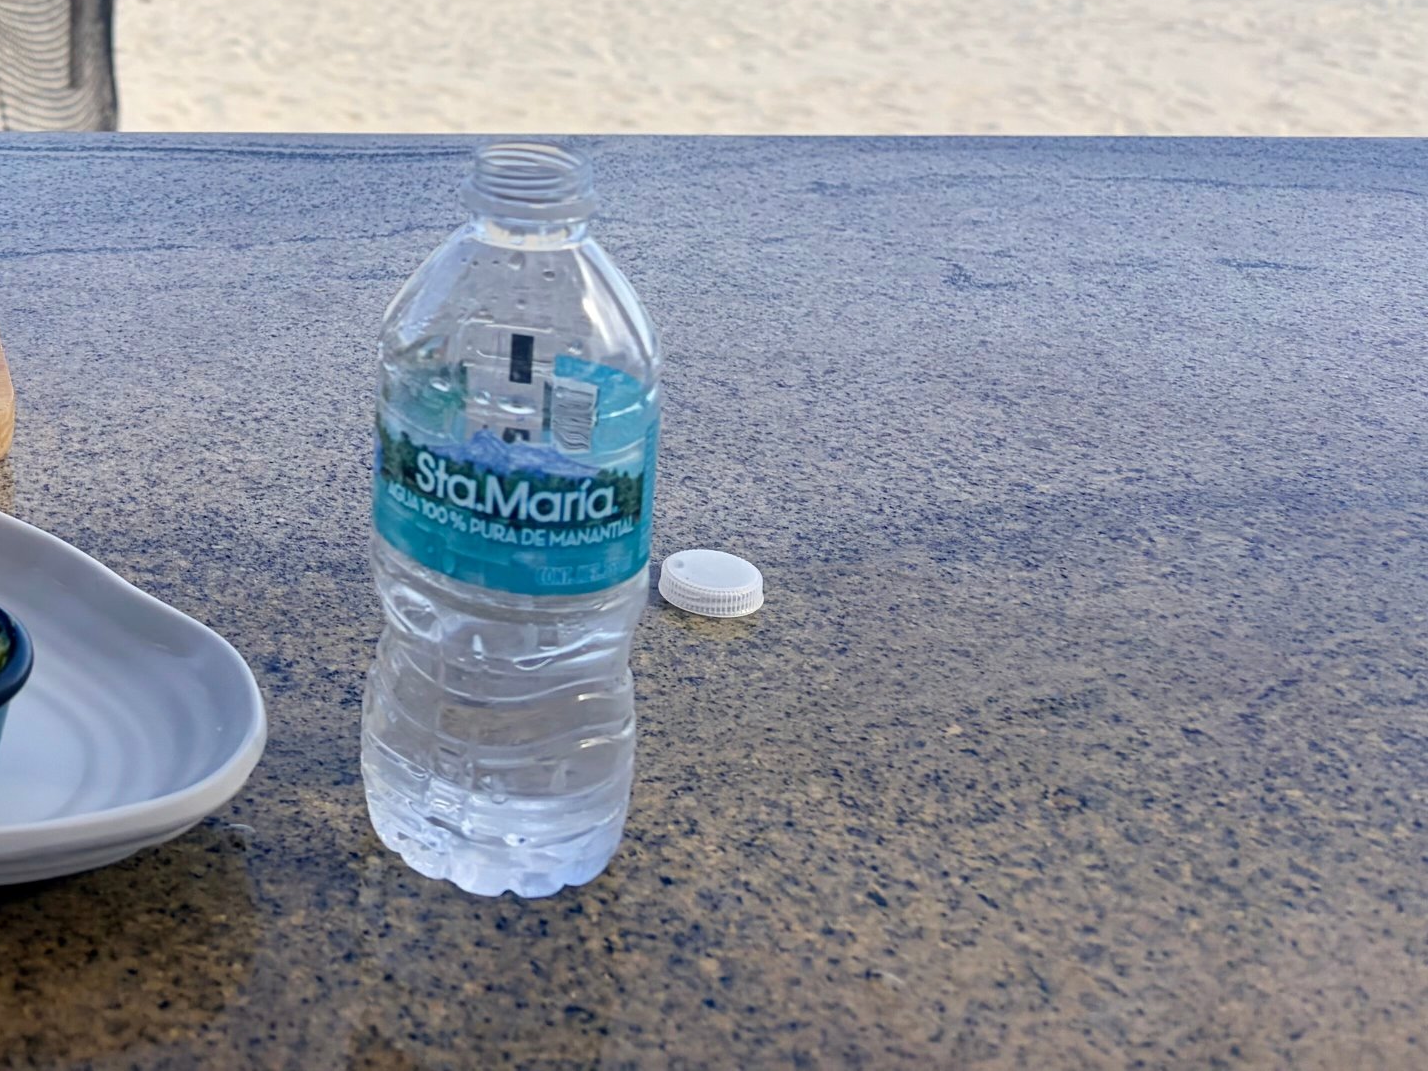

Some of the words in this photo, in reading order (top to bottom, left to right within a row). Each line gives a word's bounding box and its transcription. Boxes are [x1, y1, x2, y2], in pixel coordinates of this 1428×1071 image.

[388, 480, 420, 512] AGUA
[470, 517, 517, 545] PURA
[521, 528, 546, 547] DE
[549, 515, 634, 547] MANANTIAL
[415, 451, 614, 523] Sta.María
